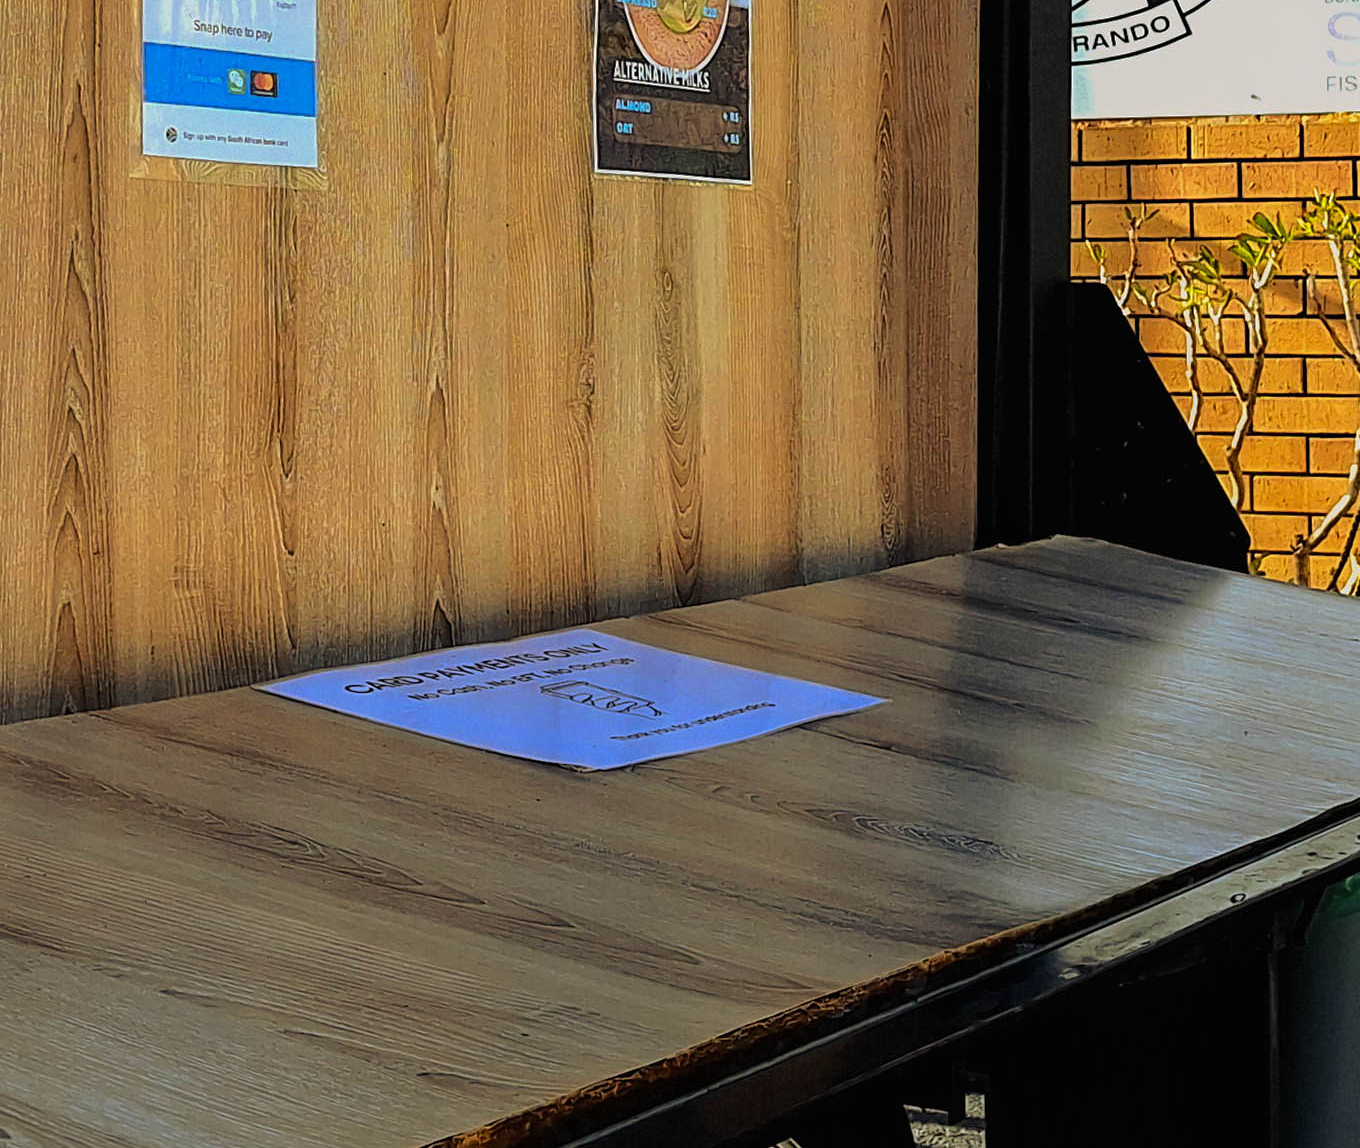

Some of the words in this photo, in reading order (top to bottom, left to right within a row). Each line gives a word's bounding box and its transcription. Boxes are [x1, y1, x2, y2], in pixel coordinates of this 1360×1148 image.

[193, 19, 219, 36] Snap
[221, 22, 243, 37] here
[244, 27, 254, 38] to
[255, 29, 273, 43] pay
[613, 60, 680, 86] ALTERNATIVE
[681, 68, 711, 89] MILKS
[615, 98, 652, 113] ALMOND
[616, 122, 633, 134] OAT
[343, 674, 424, 695] CARD
[418, 653, 549, 681] PAYMENTS
[542, 643, 609, 660] ONLY
[408, 692, 440, 702] No
[489, 679, 516, 689] No
[544, 668, 573, 677] No
[568, 657, 635, 672] Change
